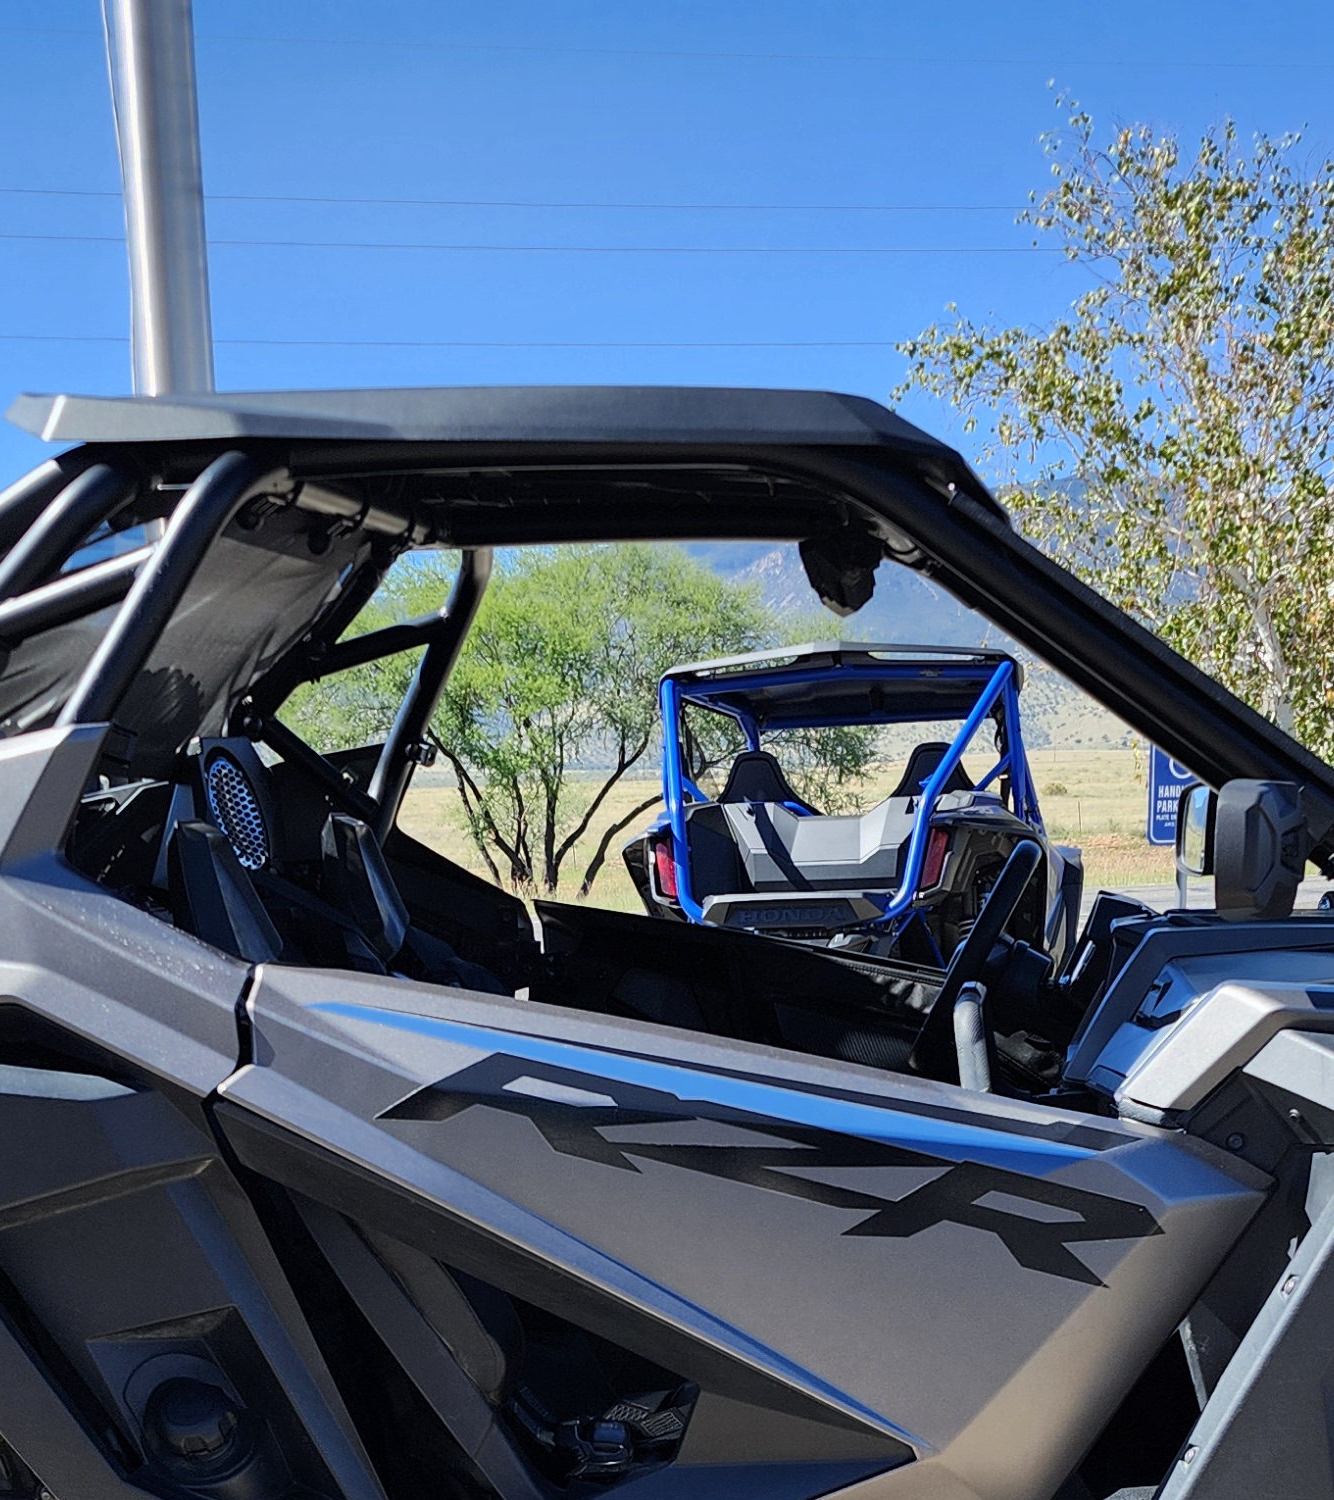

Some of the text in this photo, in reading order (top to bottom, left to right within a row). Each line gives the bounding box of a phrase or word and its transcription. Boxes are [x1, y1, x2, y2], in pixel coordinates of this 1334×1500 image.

[1158, 784, 1186, 799] HAND
[738, 906, 844, 923] HONDA
[375, 1052, 1165, 1288] RZR
